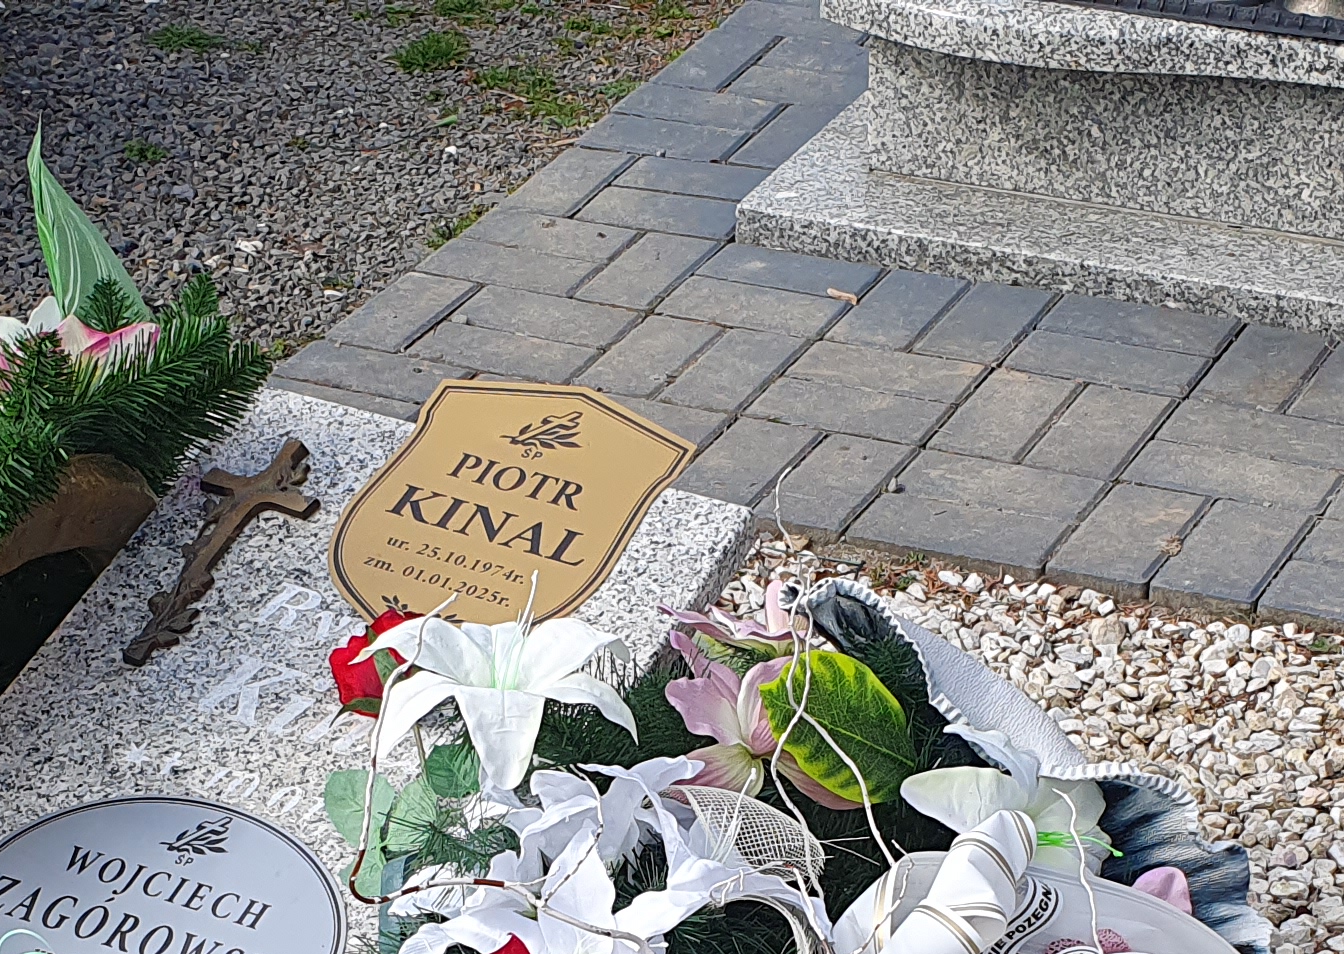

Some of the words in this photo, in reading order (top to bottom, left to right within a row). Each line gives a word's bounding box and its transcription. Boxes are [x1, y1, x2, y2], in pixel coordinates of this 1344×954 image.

[447, 452, 584, 511] PIOTR
[385, 484, 585, 567] KINAL
[363, 556, 395, 573] zm.
[387, 535, 409, 551] ur.
[415, 543, 525, 585] 25.10.1974r.
[65, 845, 272, 930] WOJCIECH
